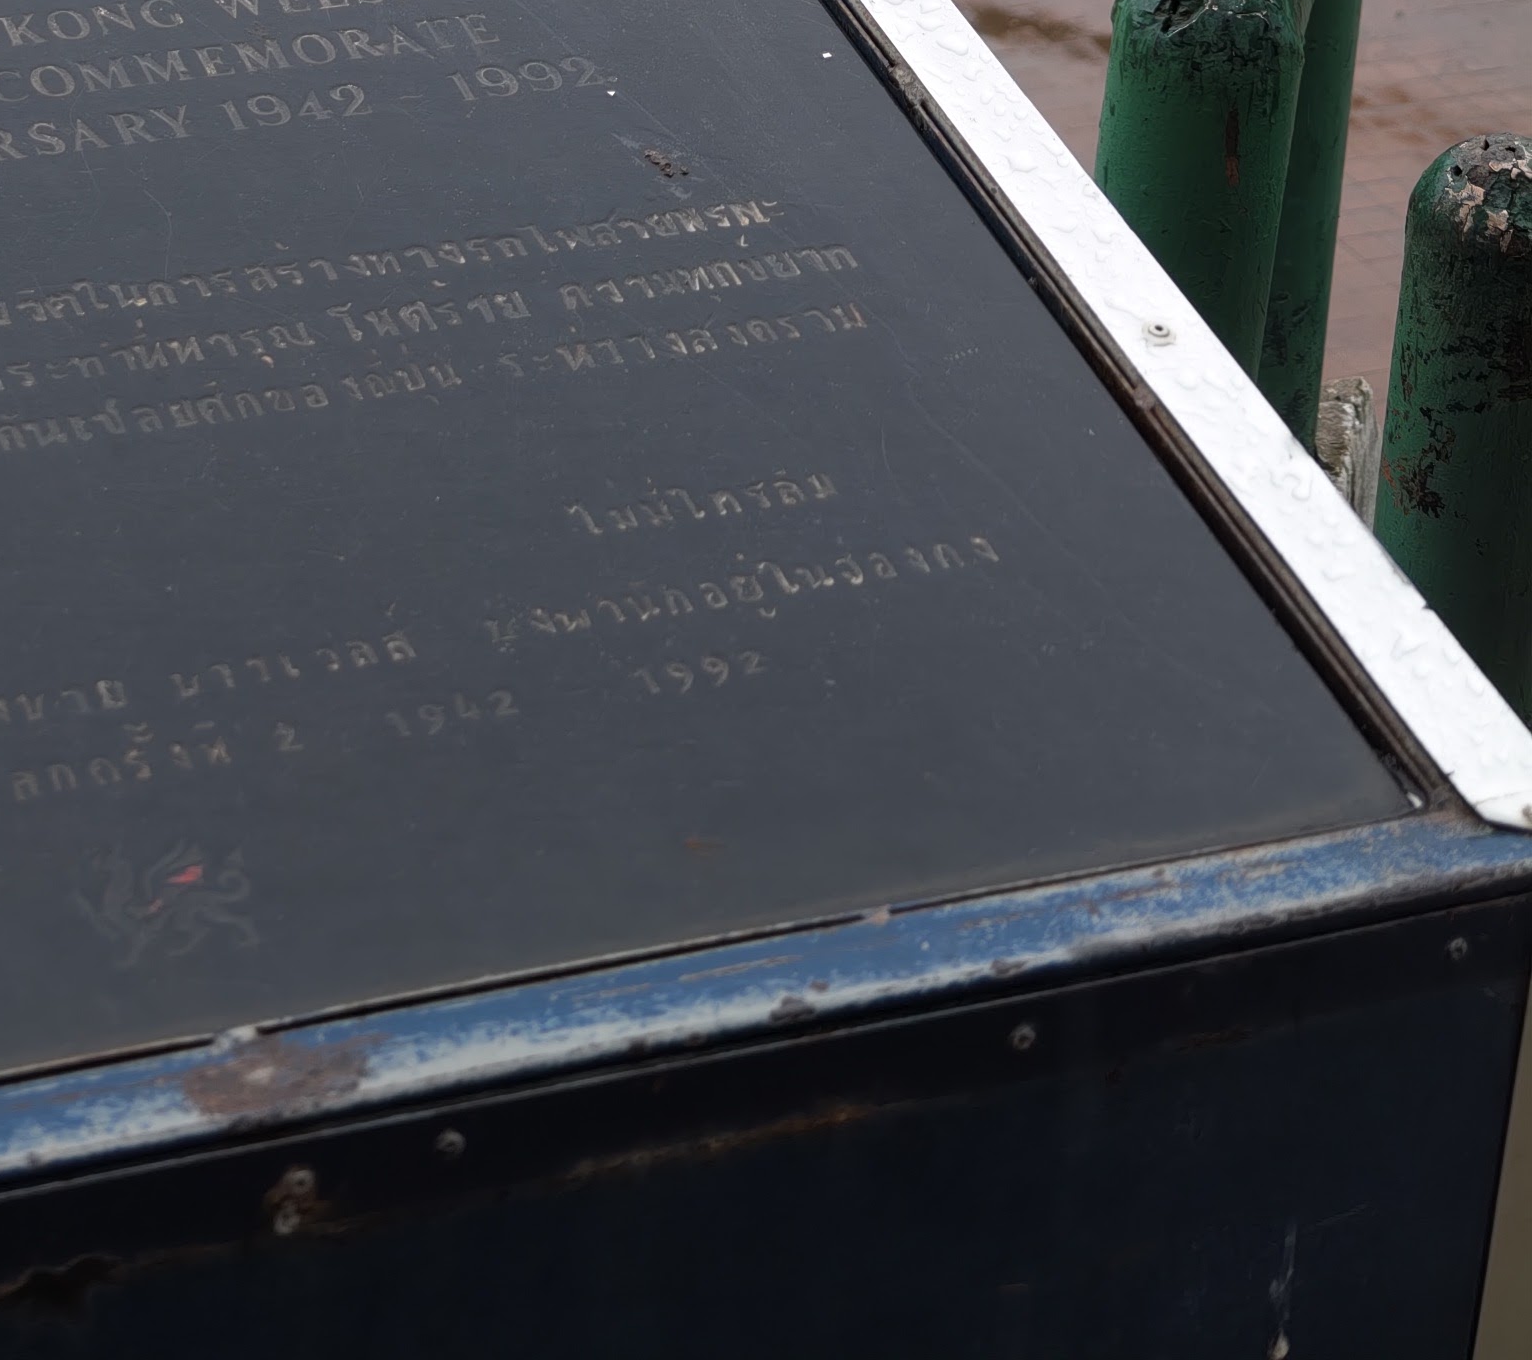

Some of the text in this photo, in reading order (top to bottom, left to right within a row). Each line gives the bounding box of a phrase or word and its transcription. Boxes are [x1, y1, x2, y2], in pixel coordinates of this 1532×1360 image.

[221, 83, 373, 135] 1942
[384, 688, 520, 739] 1942
[630, 648, 768, 696] 1992
